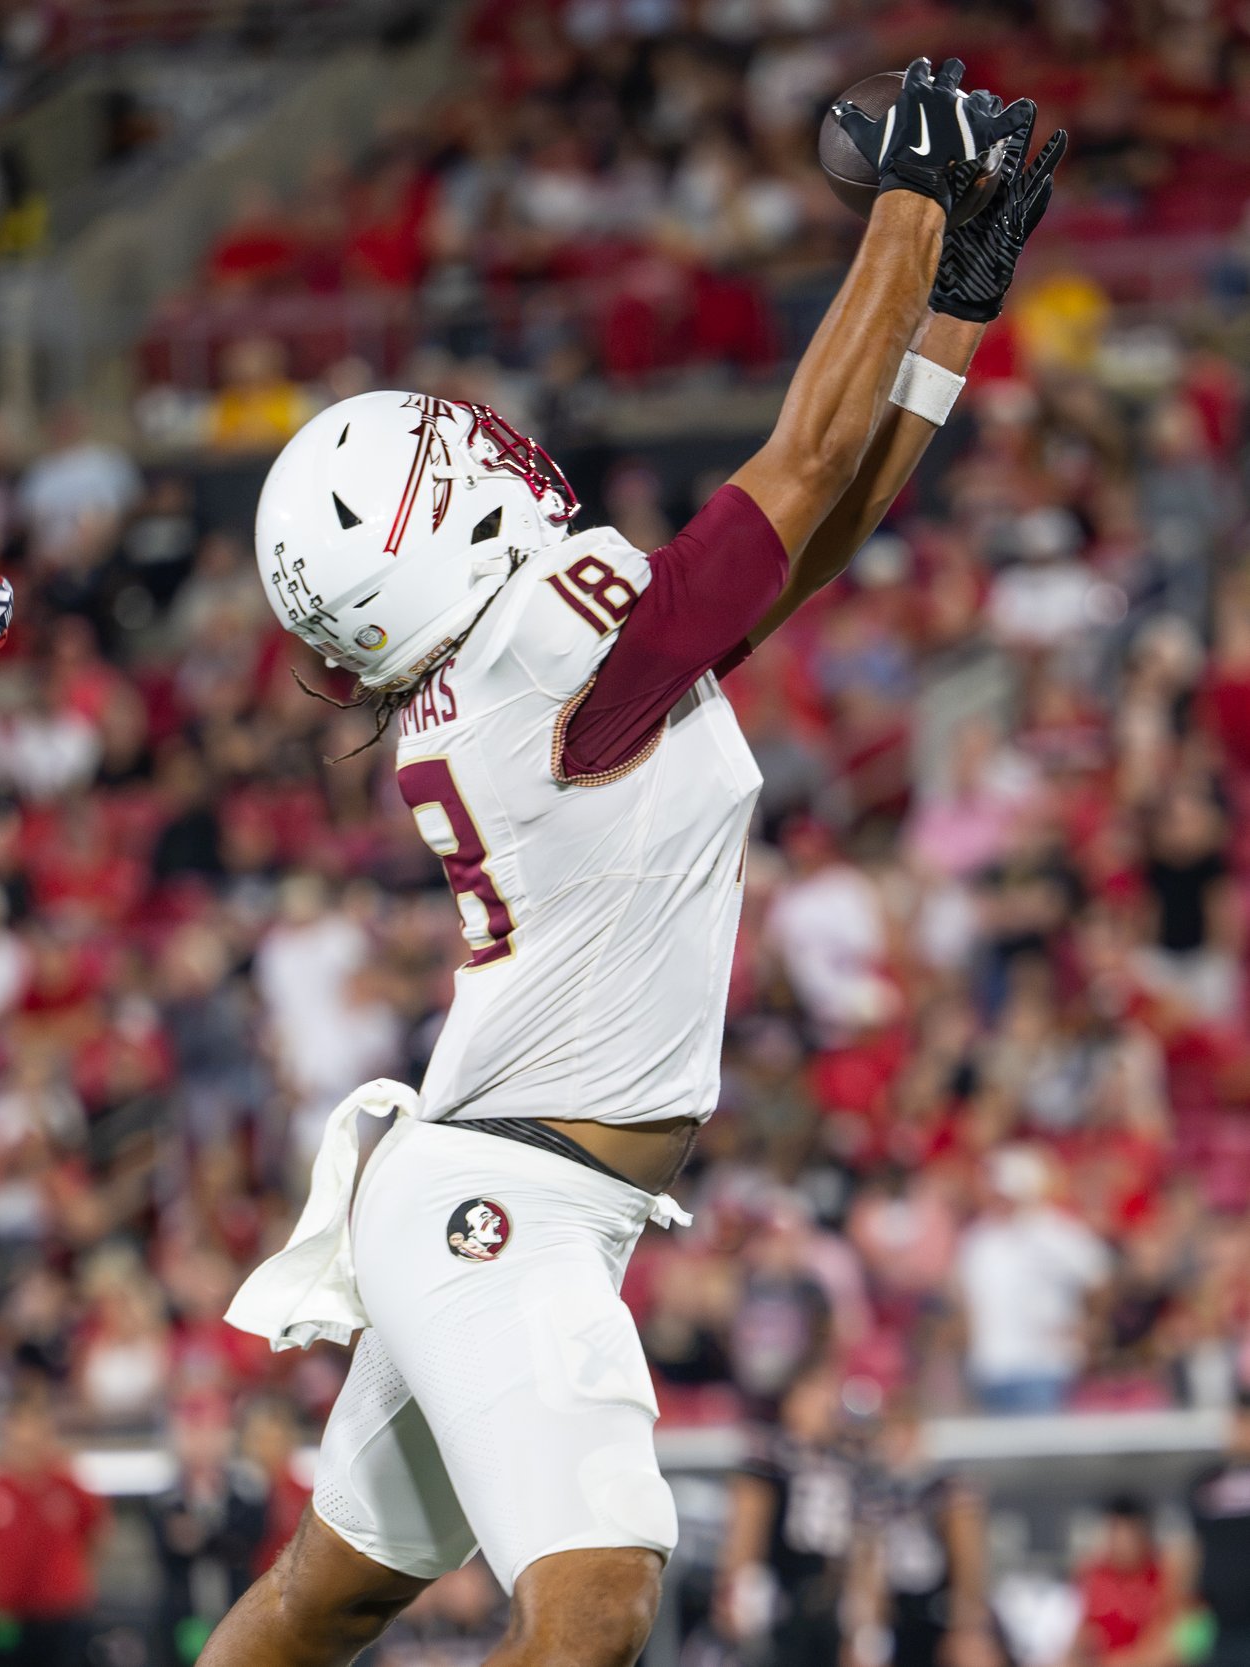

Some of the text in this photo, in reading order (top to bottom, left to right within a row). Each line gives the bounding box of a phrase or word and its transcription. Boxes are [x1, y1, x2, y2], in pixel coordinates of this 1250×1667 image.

[541, 554, 638, 639] 18
[399, 657, 457, 737] MAS
[395, 753, 518, 974] 8
